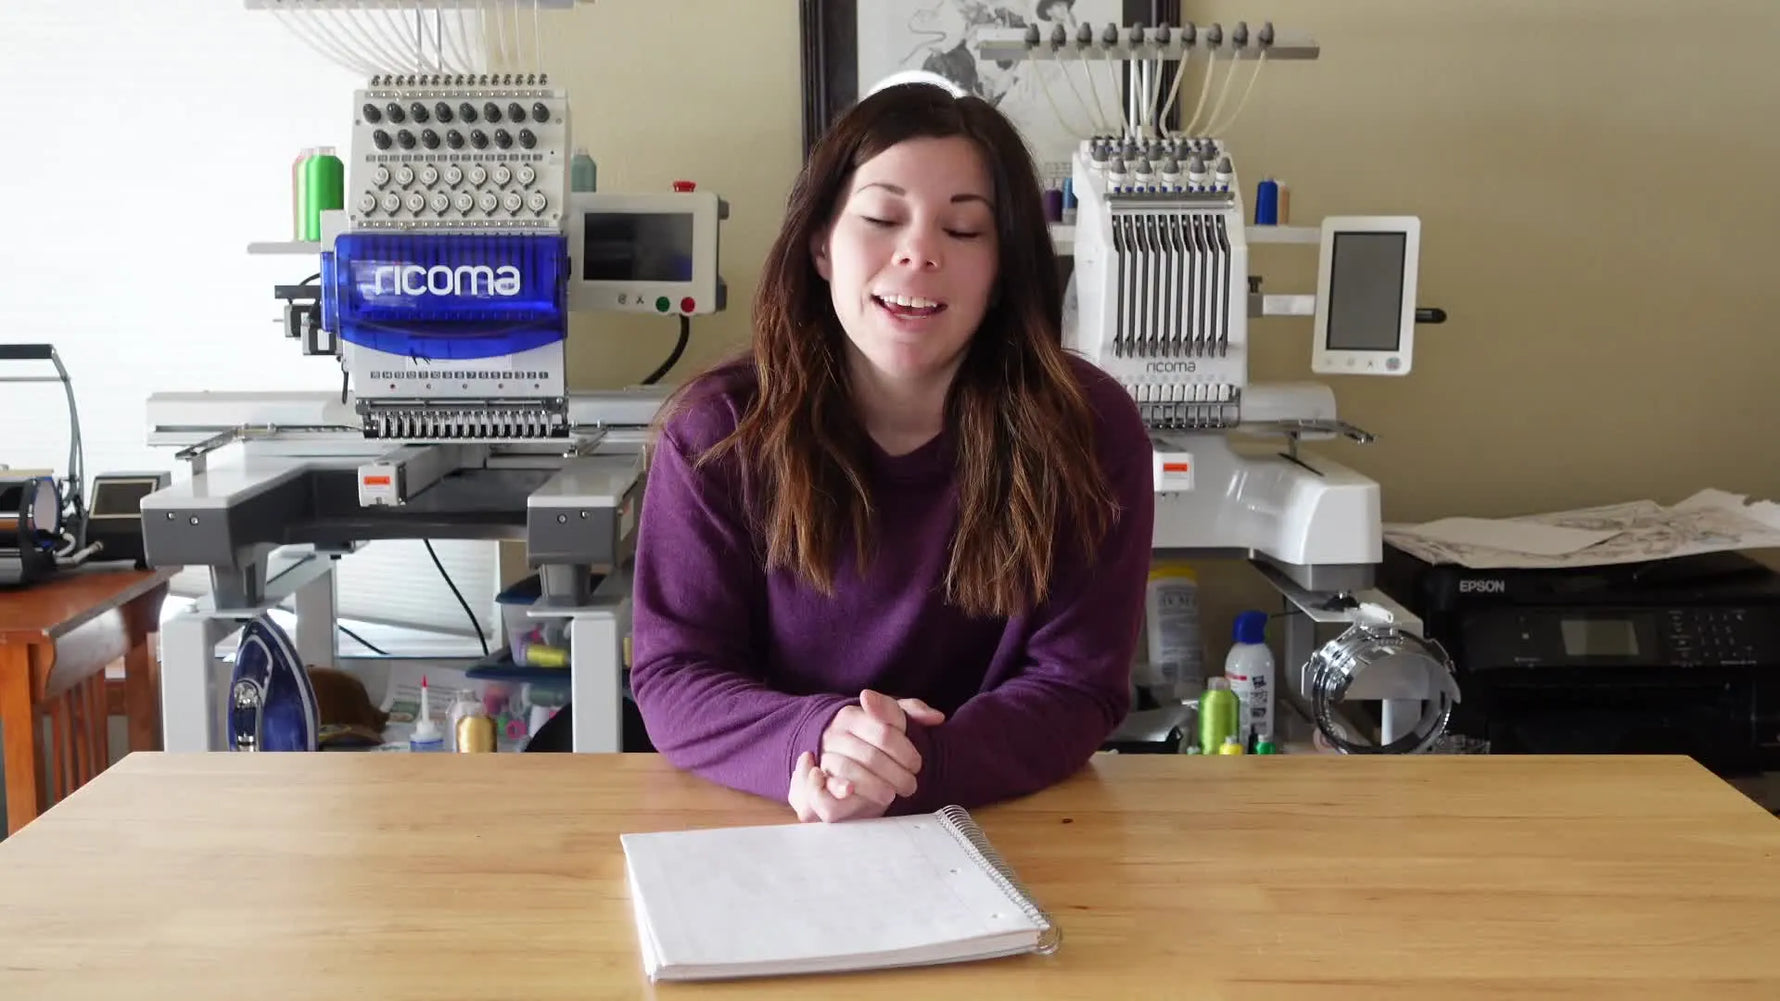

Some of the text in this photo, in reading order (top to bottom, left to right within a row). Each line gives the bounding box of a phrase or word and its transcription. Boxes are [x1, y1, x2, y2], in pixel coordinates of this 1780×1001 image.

[375, 262, 520, 296] ricoma
[1146, 361, 1196, 373] ricoma
[1459, 580, 1505, 593] EPSON
